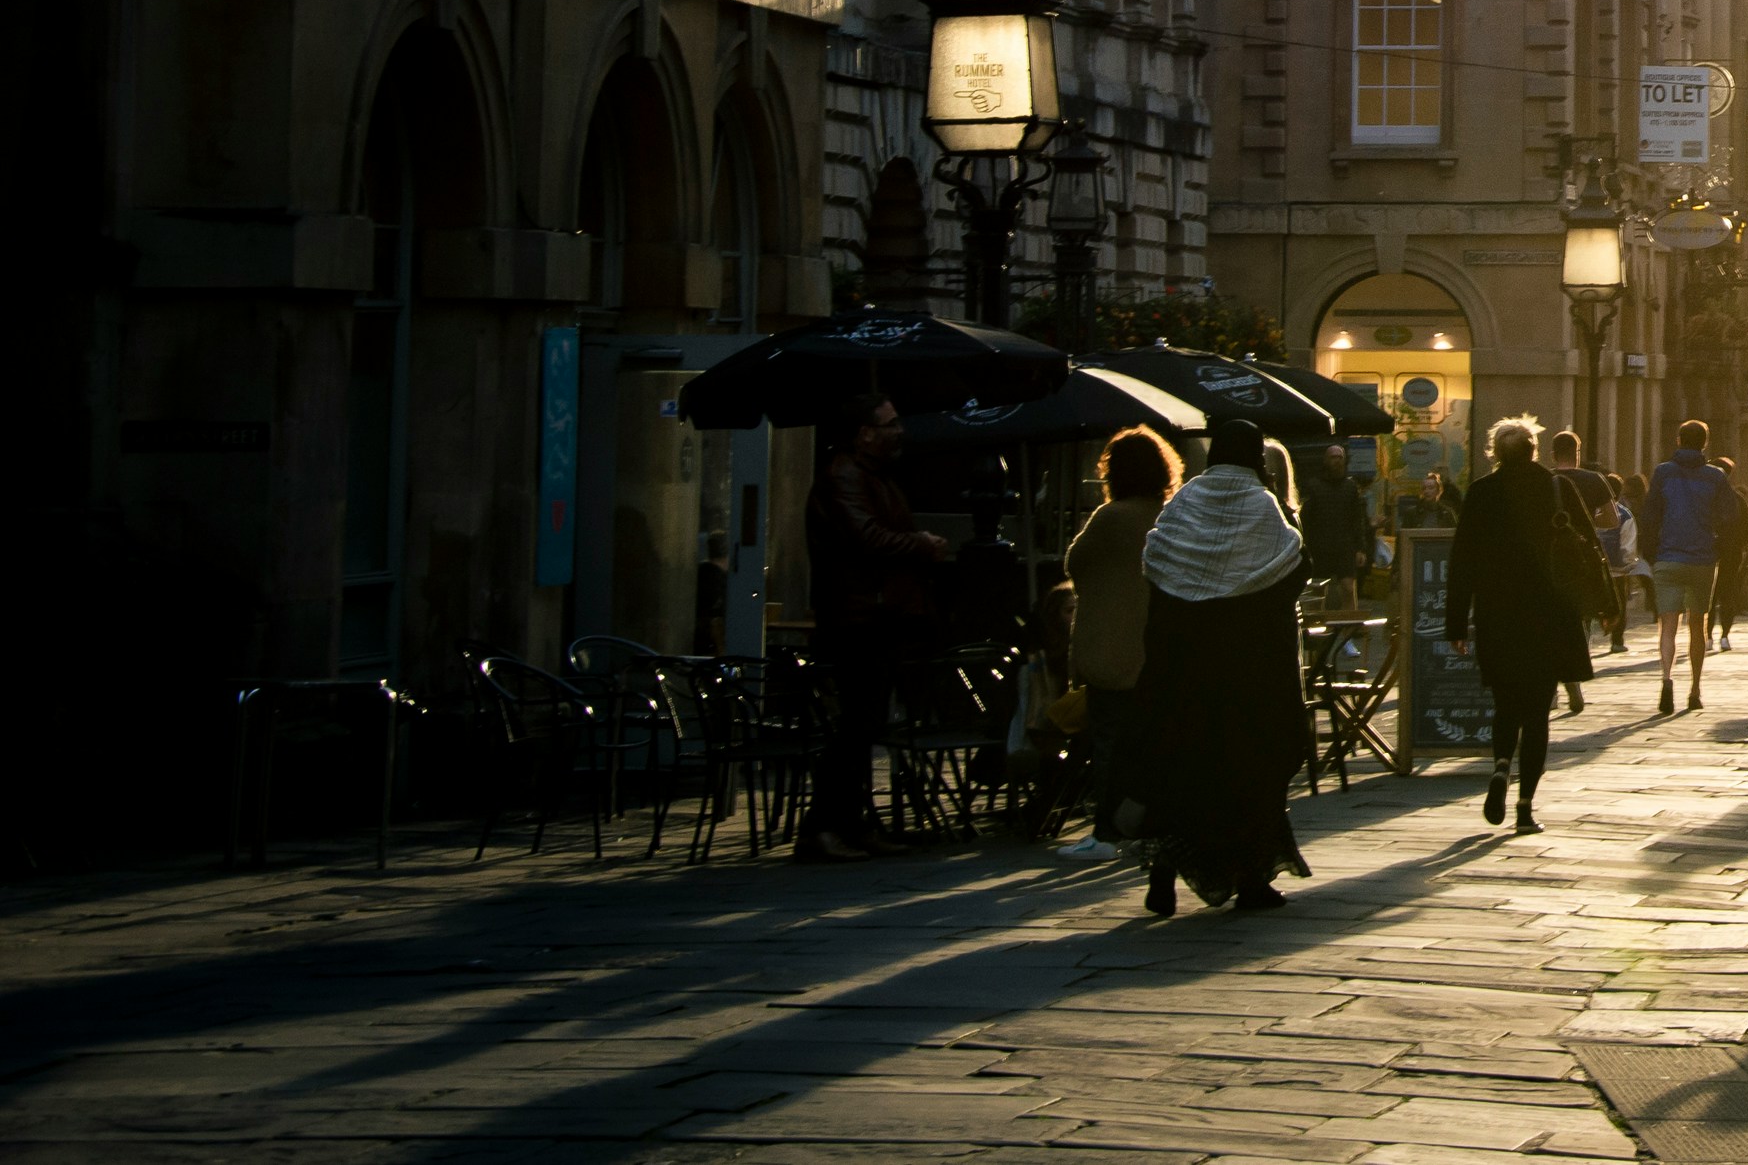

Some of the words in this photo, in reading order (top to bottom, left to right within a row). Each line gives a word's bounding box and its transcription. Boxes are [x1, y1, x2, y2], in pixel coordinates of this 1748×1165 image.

[973, 53, 988, 63] THE
[954, 64, 1004, 78] RUMMER
[967, 78, 992, 88] HOTEL
[1642, 84, 1666, 103] TO
[1672, 84, 1705, 103] LET
[1450, 708, 1480, 718] MUCH
